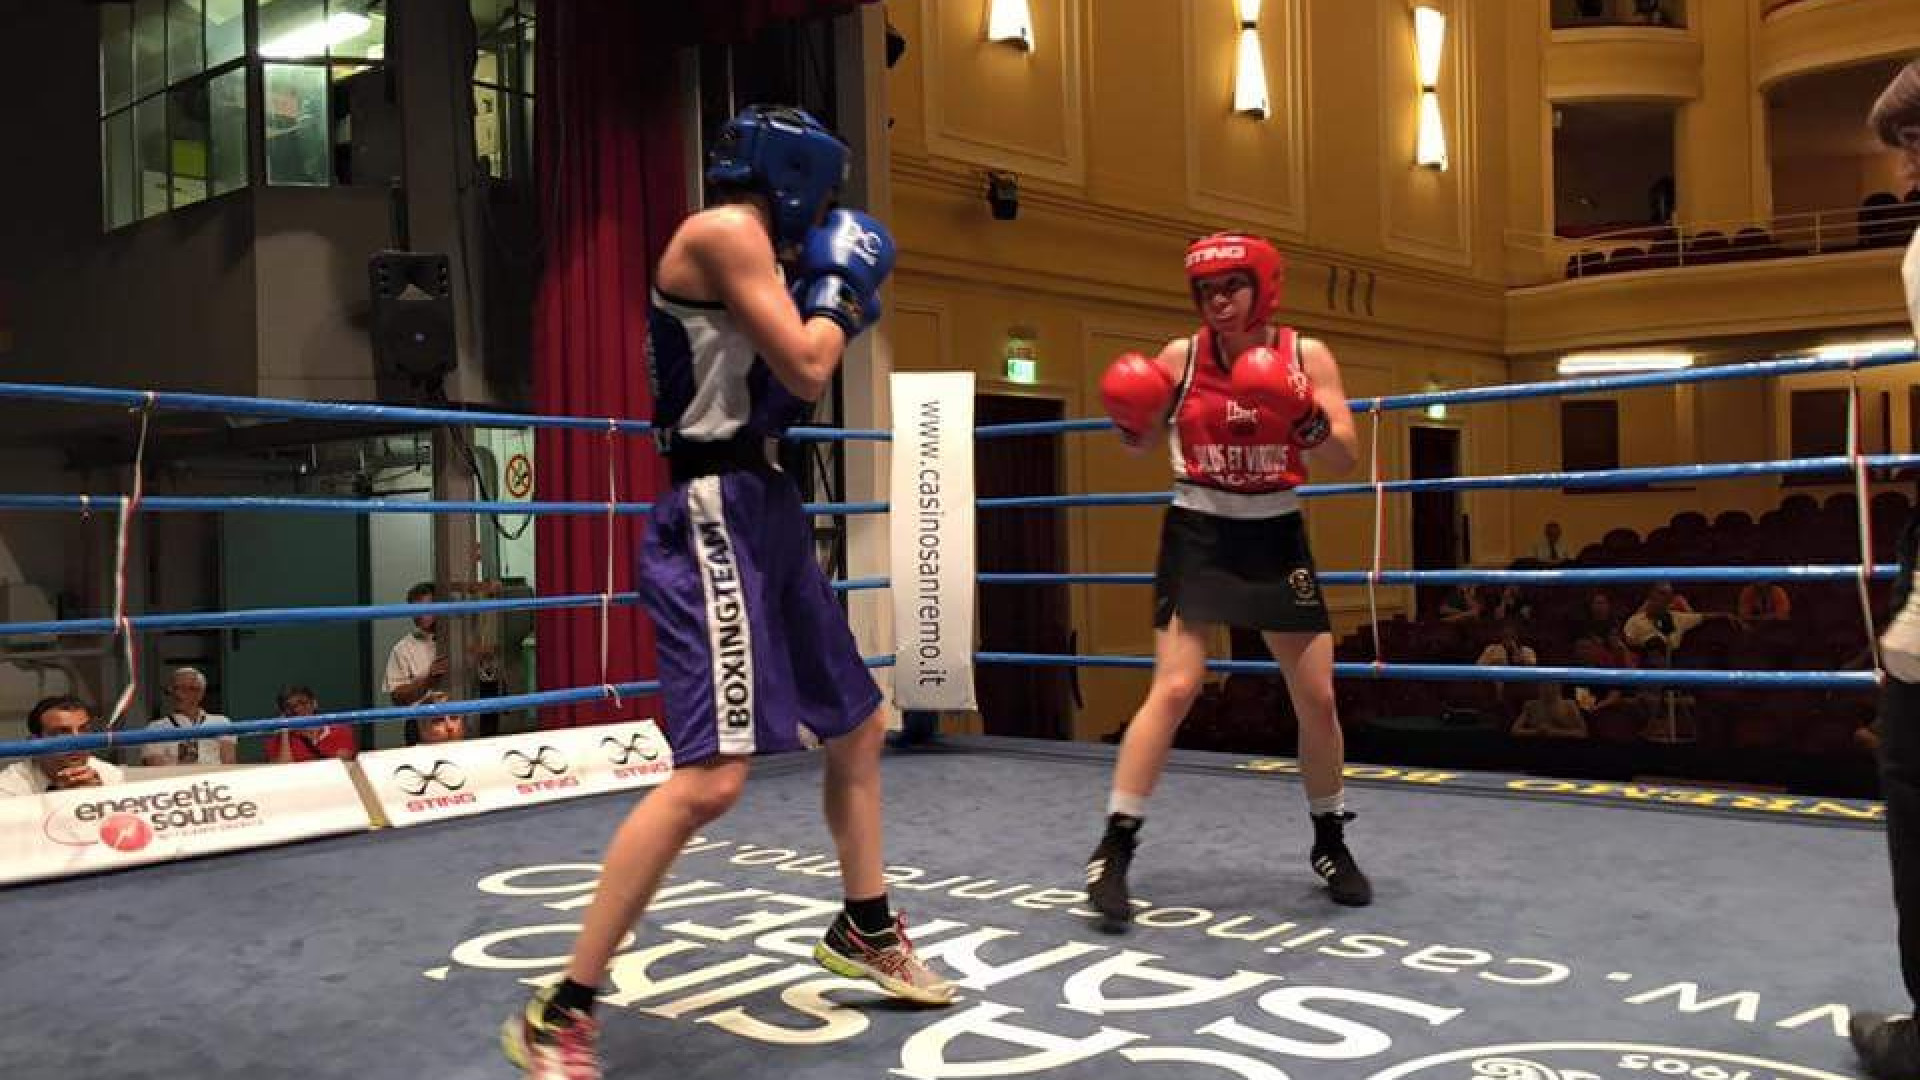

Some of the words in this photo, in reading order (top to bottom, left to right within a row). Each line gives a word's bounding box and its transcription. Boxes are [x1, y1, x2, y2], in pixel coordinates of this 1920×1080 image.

[917, 399, 947, 687] www.casinosanremo.it
[74, 780, 232, 822] energetic
[515, 775, 580, 796] STING
[151, 800, 258, 832] source
[405, 791, 477, 813] STING
